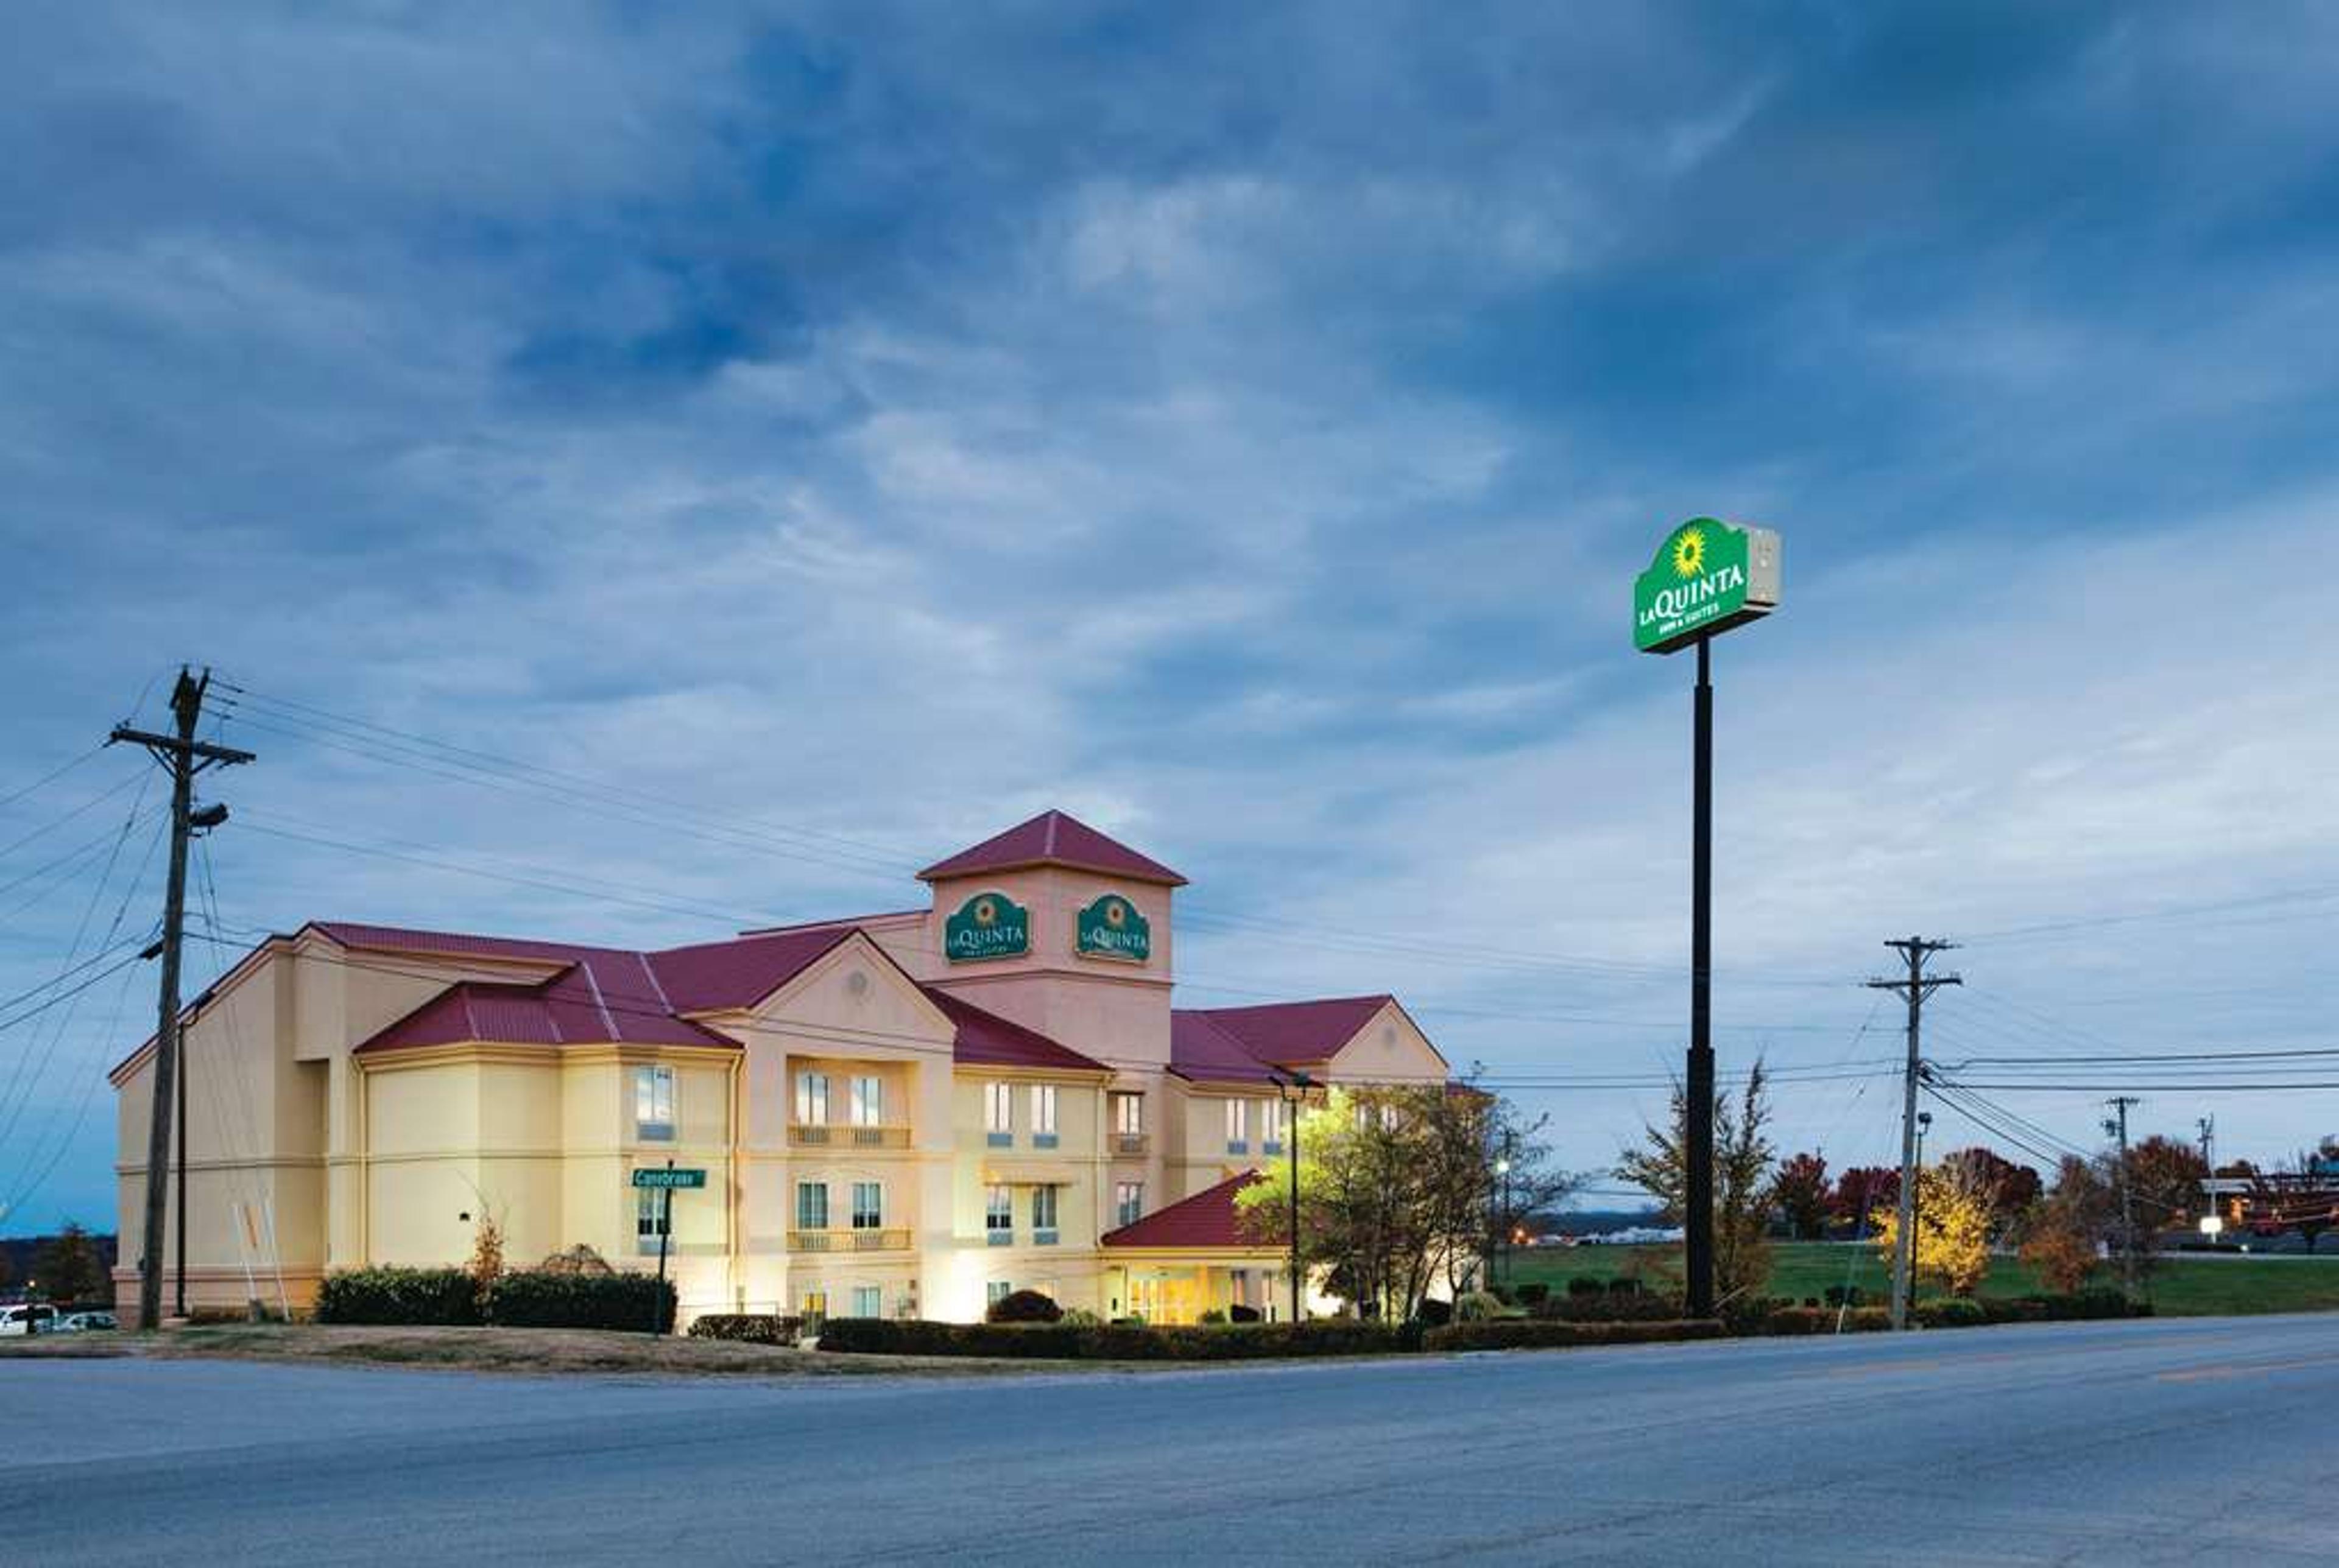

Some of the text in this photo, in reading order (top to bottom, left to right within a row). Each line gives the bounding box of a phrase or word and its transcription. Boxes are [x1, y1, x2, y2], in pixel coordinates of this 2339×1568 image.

[1640, 564, 1744, 626] LA QUINTA
[960, 926, 1024, 949] QUINTA
[1092, 926, 1146, 949] QUINTA
